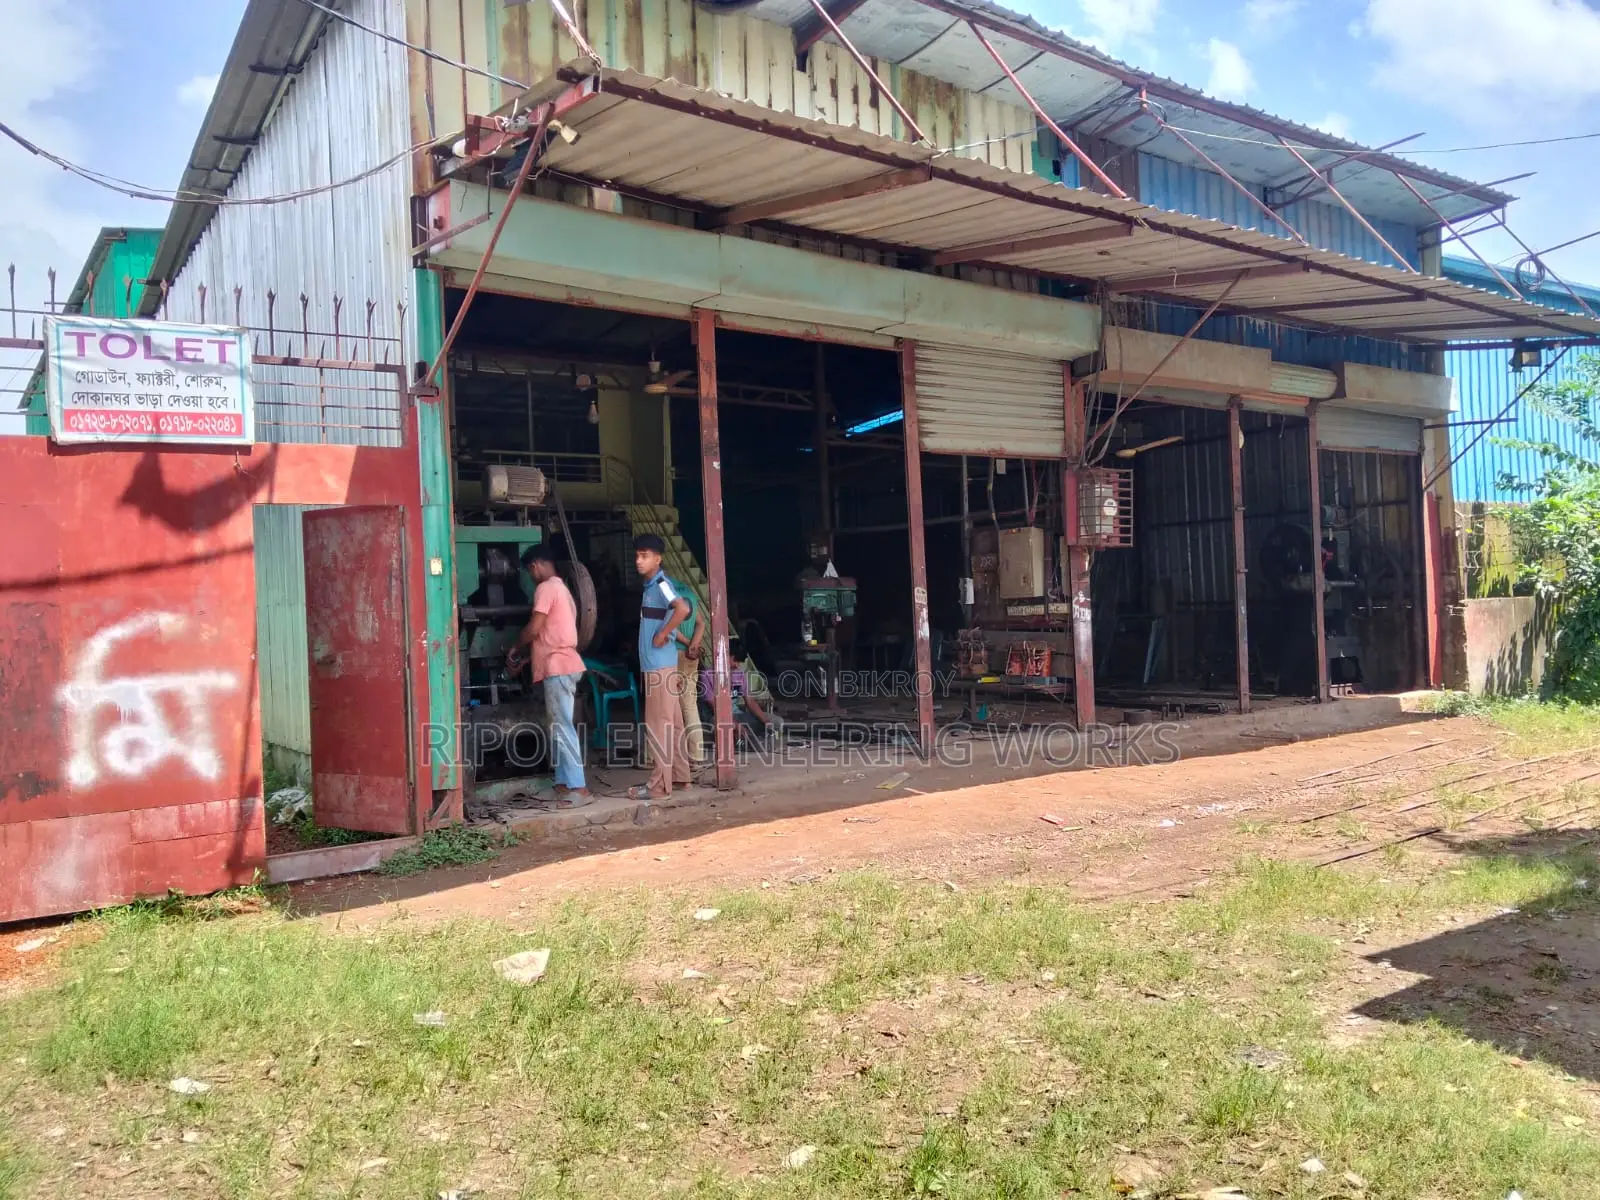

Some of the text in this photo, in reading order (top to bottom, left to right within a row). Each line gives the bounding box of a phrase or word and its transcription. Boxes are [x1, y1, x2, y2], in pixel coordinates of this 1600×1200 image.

[64, 331, 237, 364] TOLET
[75, 367, 132, 388] গোডাউন,
[184, 373, 228, 392] শোরুম,
[71, 390, 131, 406] দোকানঘর
[134, 392, 164, 409] ভাড়া
[167, 394, 204, 409] দেওয়া
